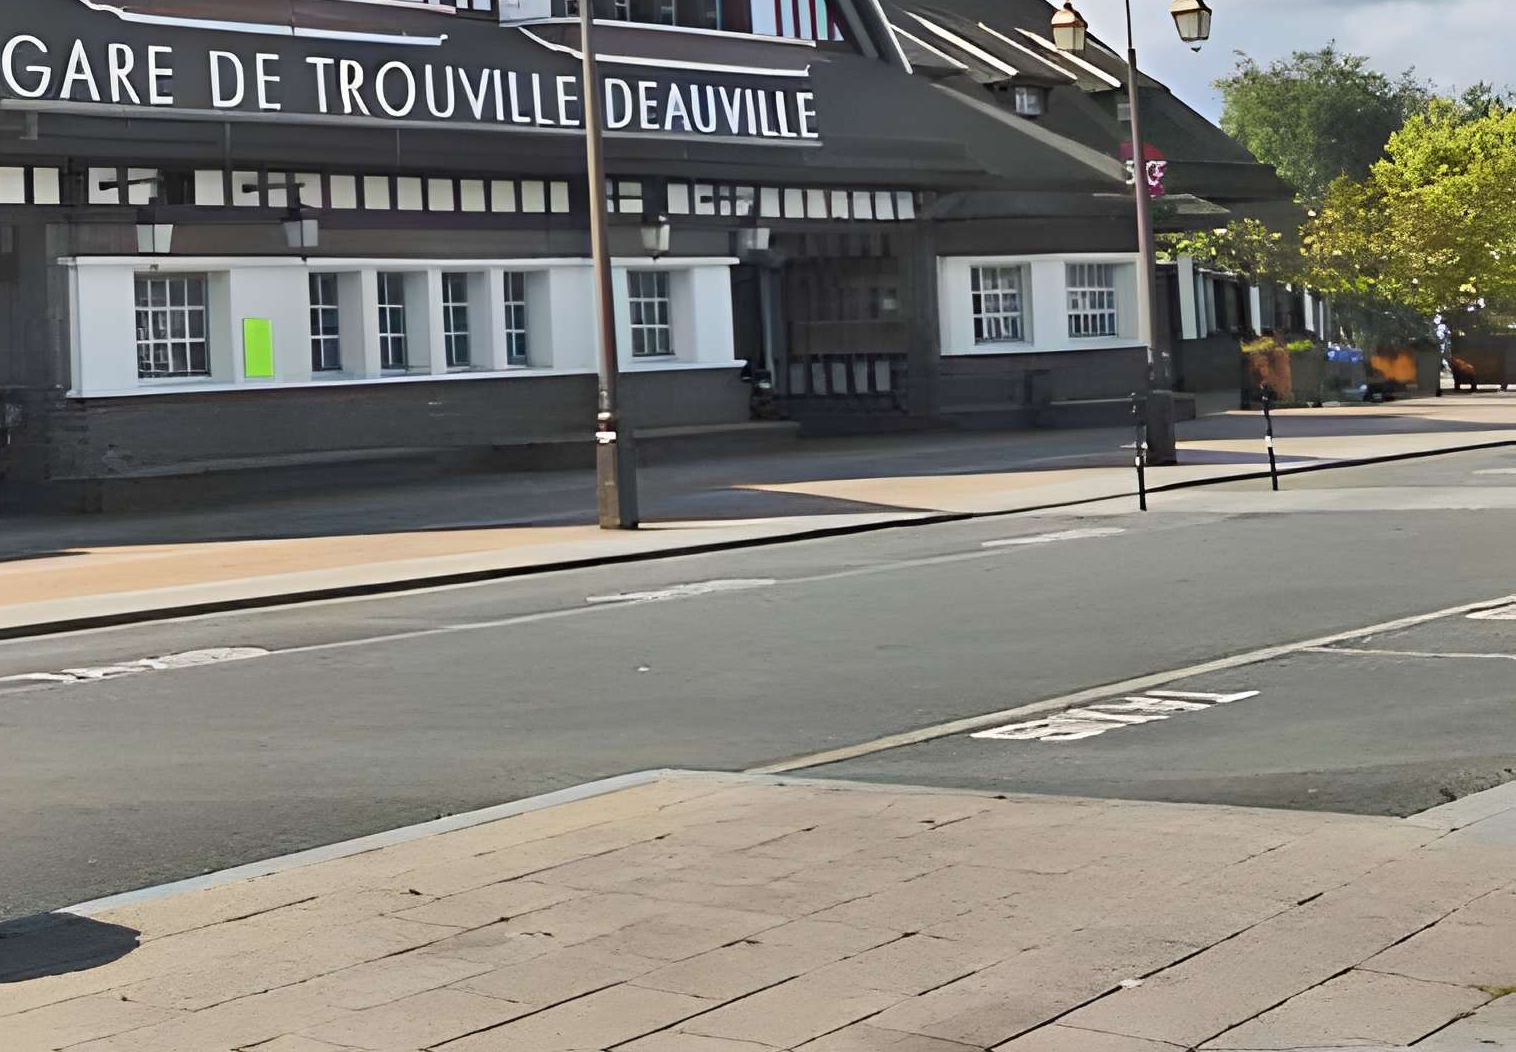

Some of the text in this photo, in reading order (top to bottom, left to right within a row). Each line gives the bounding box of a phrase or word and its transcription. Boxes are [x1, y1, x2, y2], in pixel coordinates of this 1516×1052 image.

[1, 34, 819, 138] GARE DE TROUVILLE DEAUVILLE
